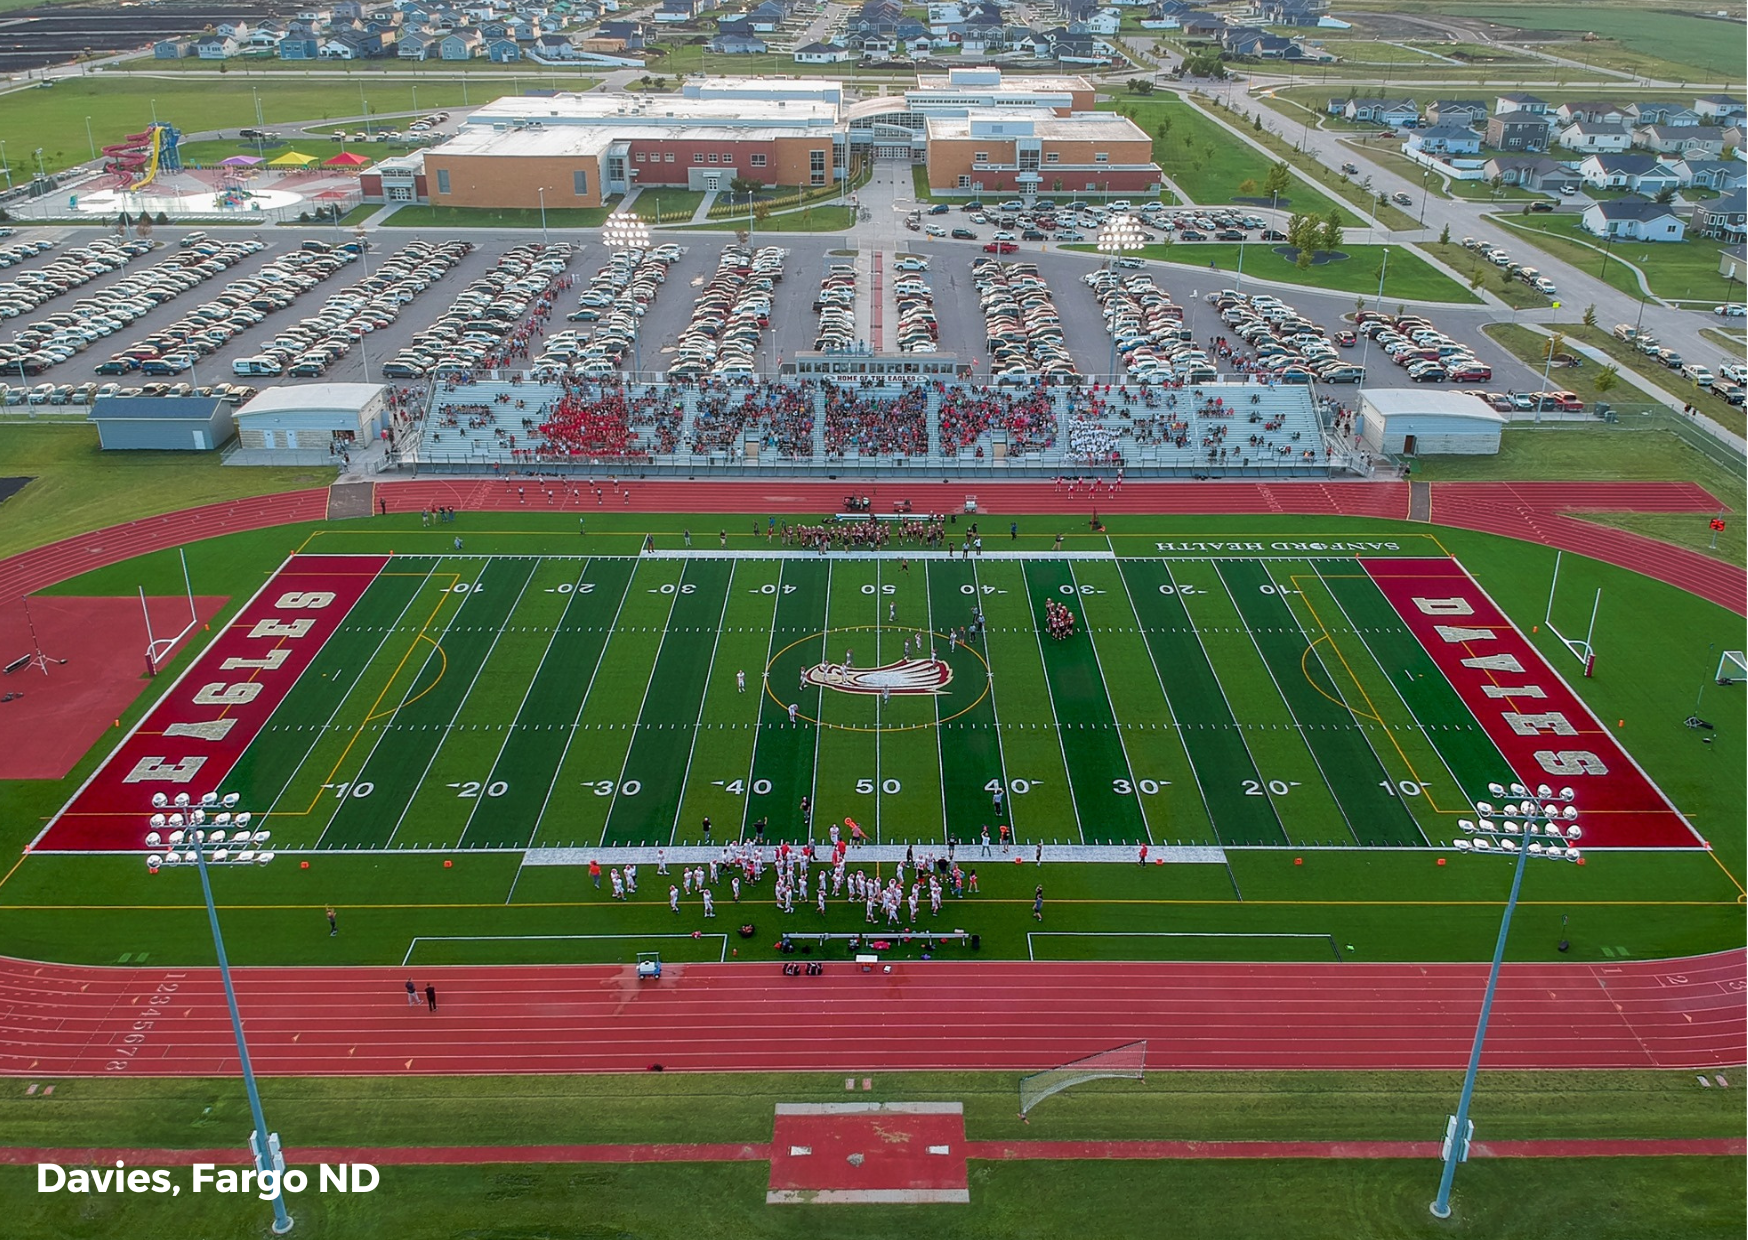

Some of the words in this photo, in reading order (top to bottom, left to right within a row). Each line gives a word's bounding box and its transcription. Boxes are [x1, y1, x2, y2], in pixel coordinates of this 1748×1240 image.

[1710, 519, 1724, 531] 25
[1155, 541, 1265, 551] HEALTH
[1270, 541, 1401, 551] SANFORD
[453, 583, 485, 594] 10
[557, 583, 596, 594] 20
[659, 584, 697, 595] 30
[760, 584, 797, 595] 40
[861, 584, 897, 595] 50
[960, 584, 996, 595] 40
[1059, 584, 1096, 595] 30
[1159, 584, 1196, 595] 20
[1259, 584, 1292, 595] 10
[122, 591, 337, 783] EAGLES
[1411, 597, 1610, 775] DAVIES
[334, 781, 375, 798] 10
[456, 780, 509, 797] 20
[593, 780, 642, 796] 30
[725, 779, 773, 795] 40
[855, 779, 902, 794] 50
[984, 779, 1030, 794] 40
[1112, 779, 1159, 795] 30
[1241, 780, 1289, 796] 20
[1379, 780, 1422, 796] 10
[163, 972, 187, 980] 1
[1601, 967, 1623, 975] 1
[1666, 975, 1689, 985] 2
[1729, 980, 1747, 990] 3
[156, 983, 179, 993] 2
[149, 995, 171, 1005] 3
[139, 1008, 162, 1017] 4
[132, 1021, 154, 1030] 5
[124, 1033, 145, 1043] 6
[116, 1046, 138, 1057] 7
[105, 1060, 128, 1071] 8
